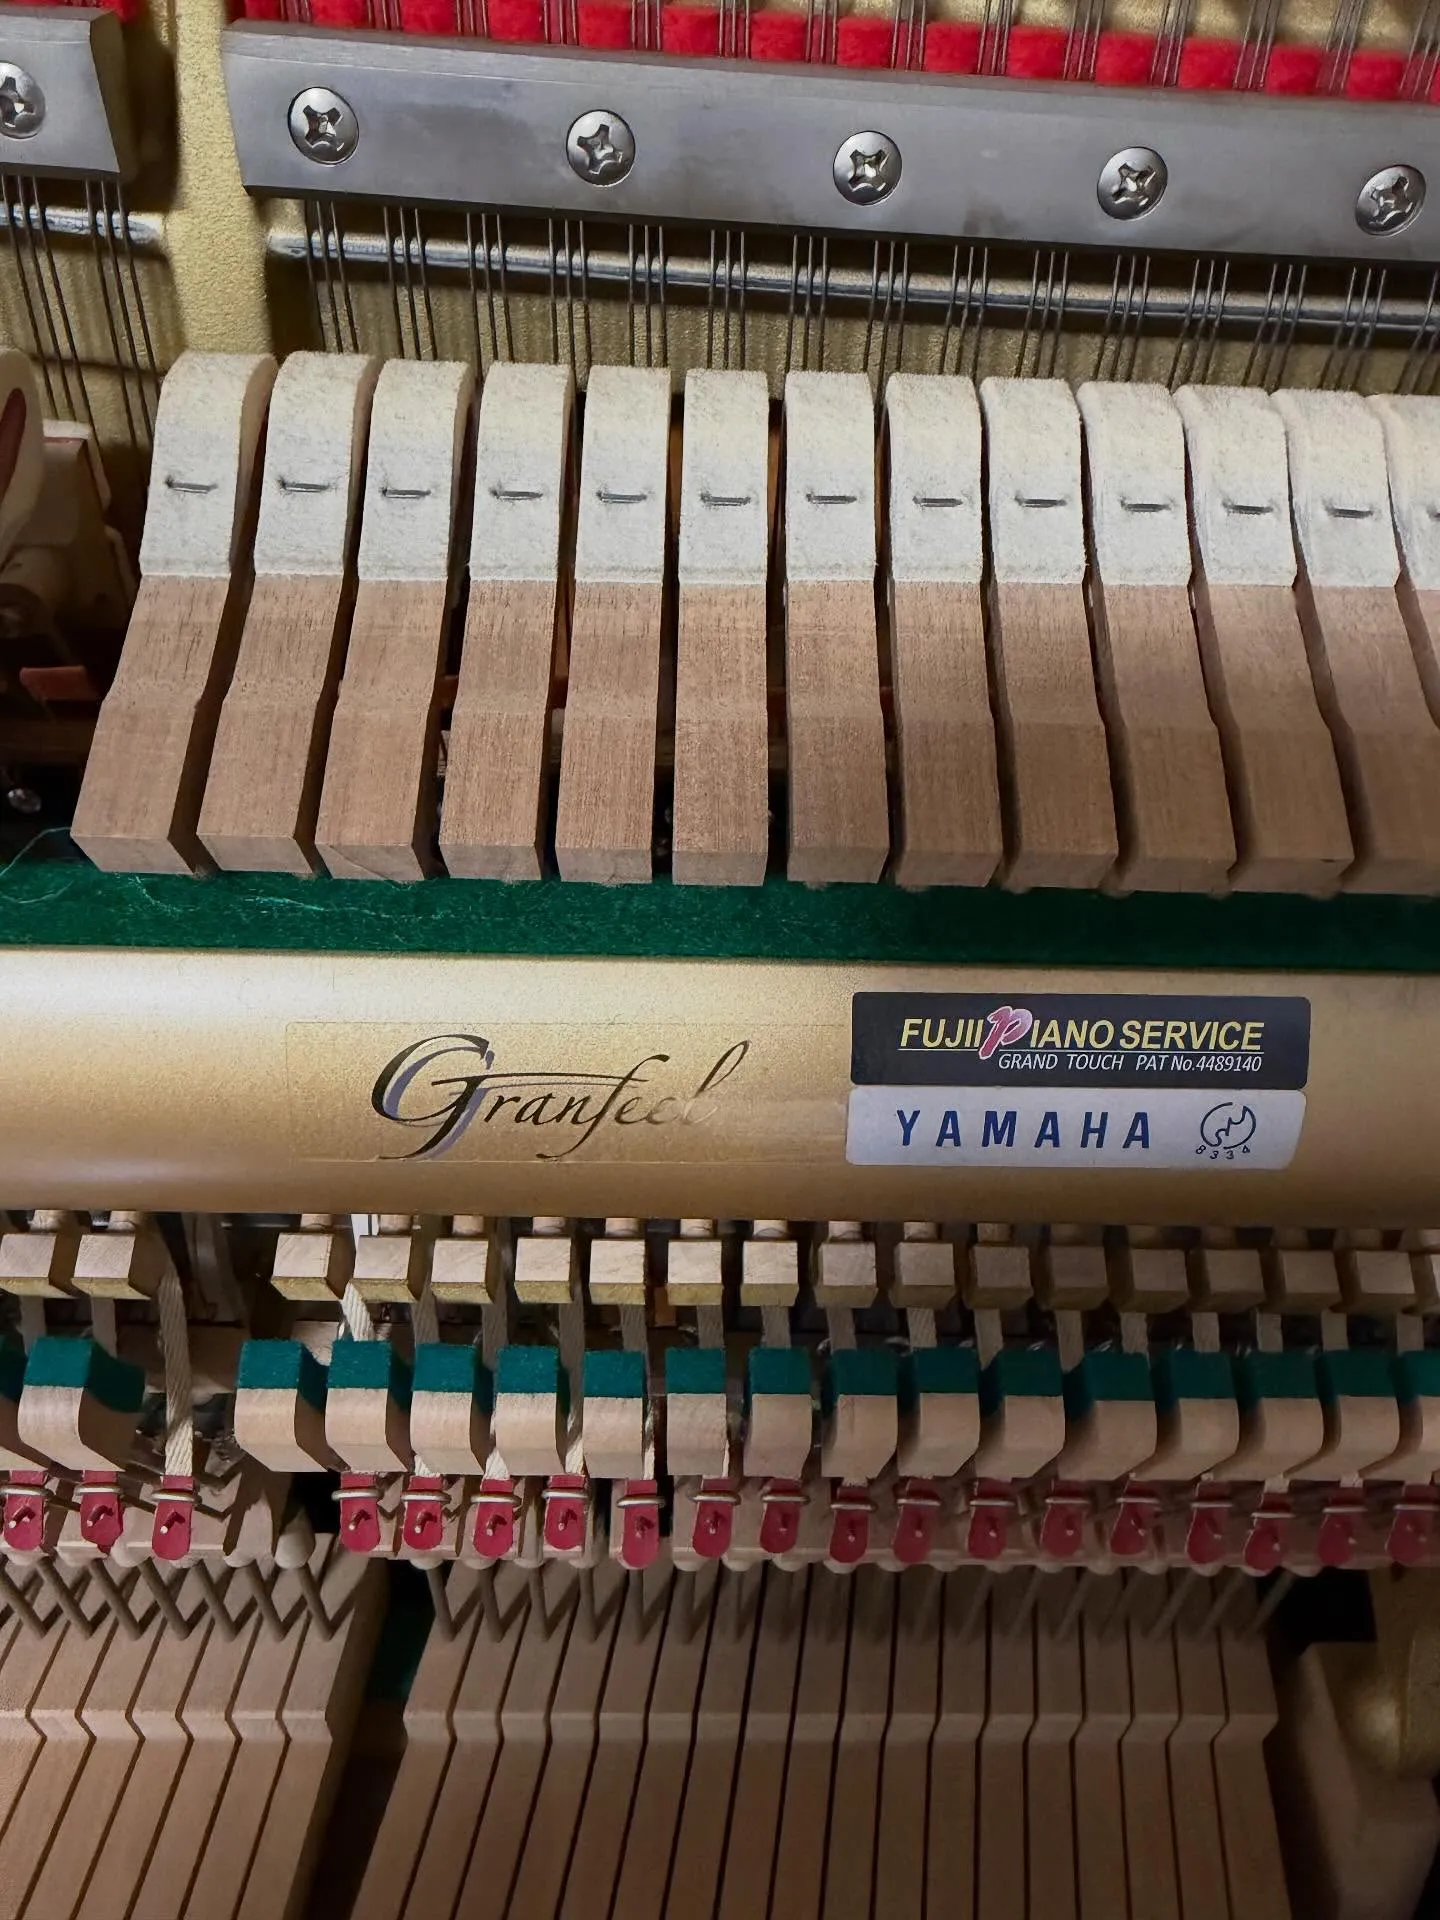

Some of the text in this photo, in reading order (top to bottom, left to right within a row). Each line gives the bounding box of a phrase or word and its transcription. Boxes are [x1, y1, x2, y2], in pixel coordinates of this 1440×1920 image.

[900, 1018, 984, 1048] FUJII
[1119, 1021, 1264, 1051] SERVICE
[998, 1053, 1058, 1070] GRAND
[1067, 1054, 1124, 1071] TOUCH
[1135, 1055, 1168, 1071] PAT
[371, 1033, 751, 1159] Granfeel
[896, 1109, 1151, 1149] YAMAHA
